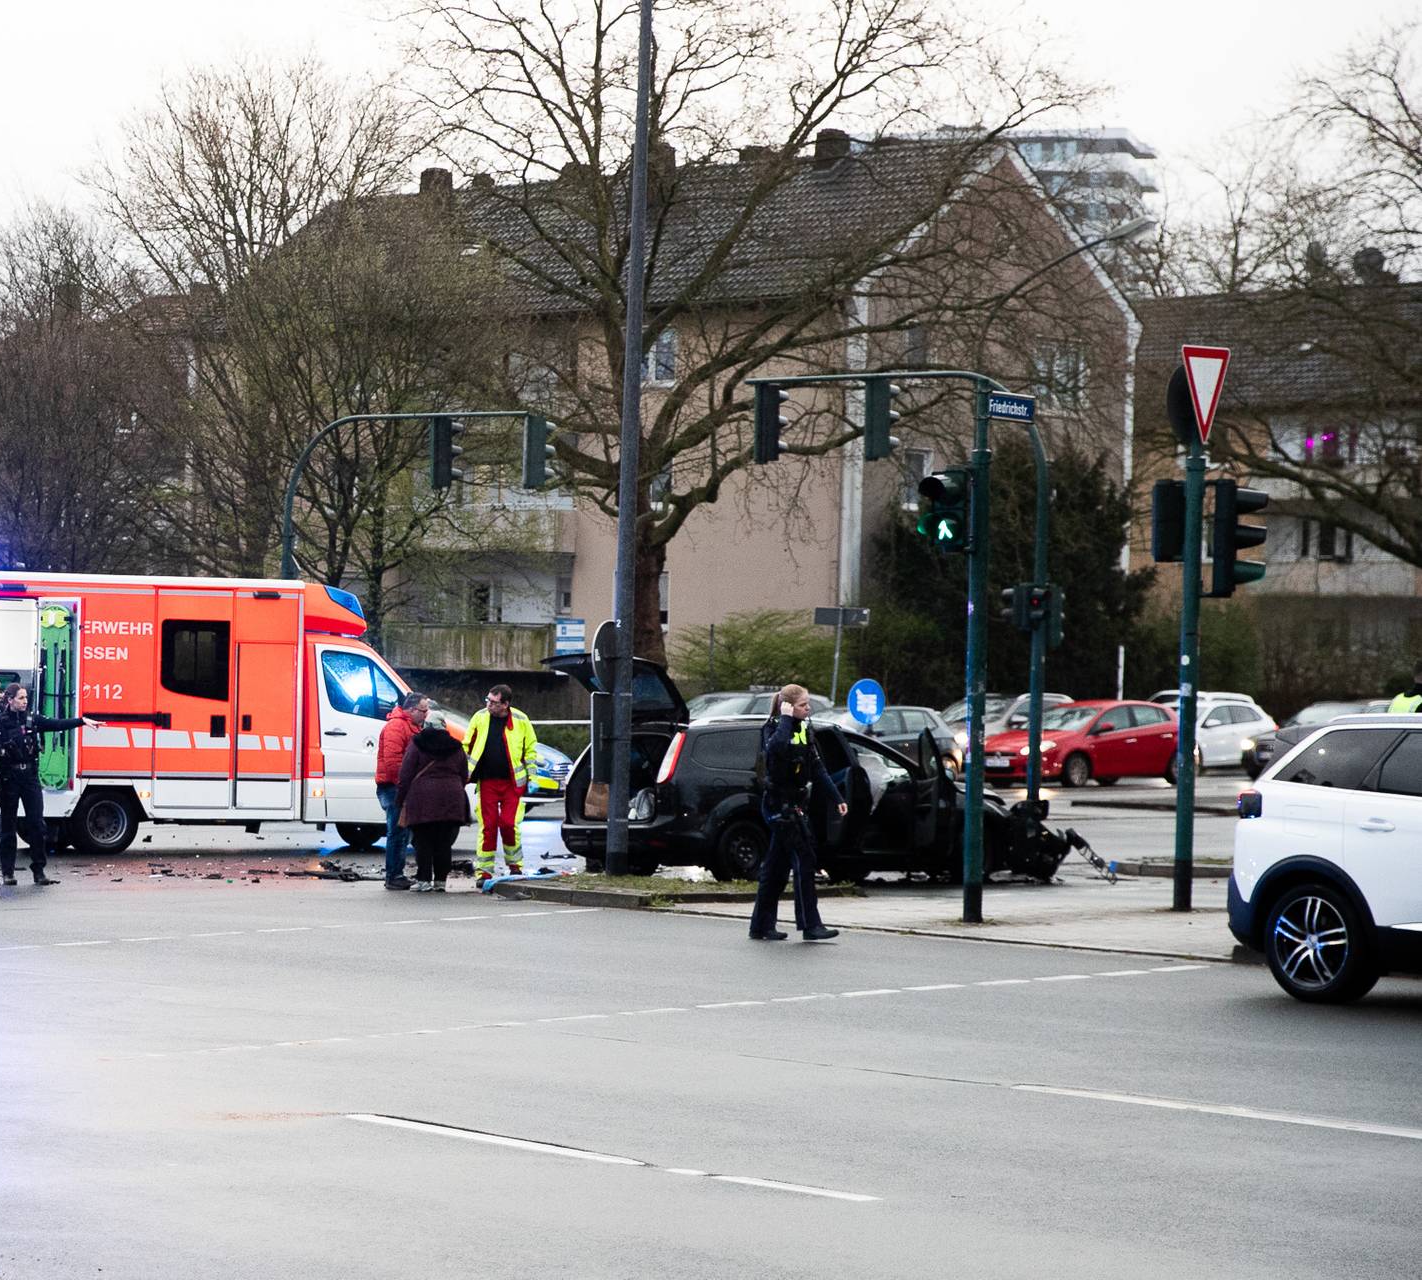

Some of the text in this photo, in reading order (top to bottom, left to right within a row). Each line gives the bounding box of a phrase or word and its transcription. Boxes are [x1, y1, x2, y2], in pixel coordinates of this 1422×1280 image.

[989, 398, 1030, 417] Friedrichstr.
[84, 620, 154, 636] ERWEHR
[83, 645, 129, 661] SSEN
[93, 683, 123, 700] 112
